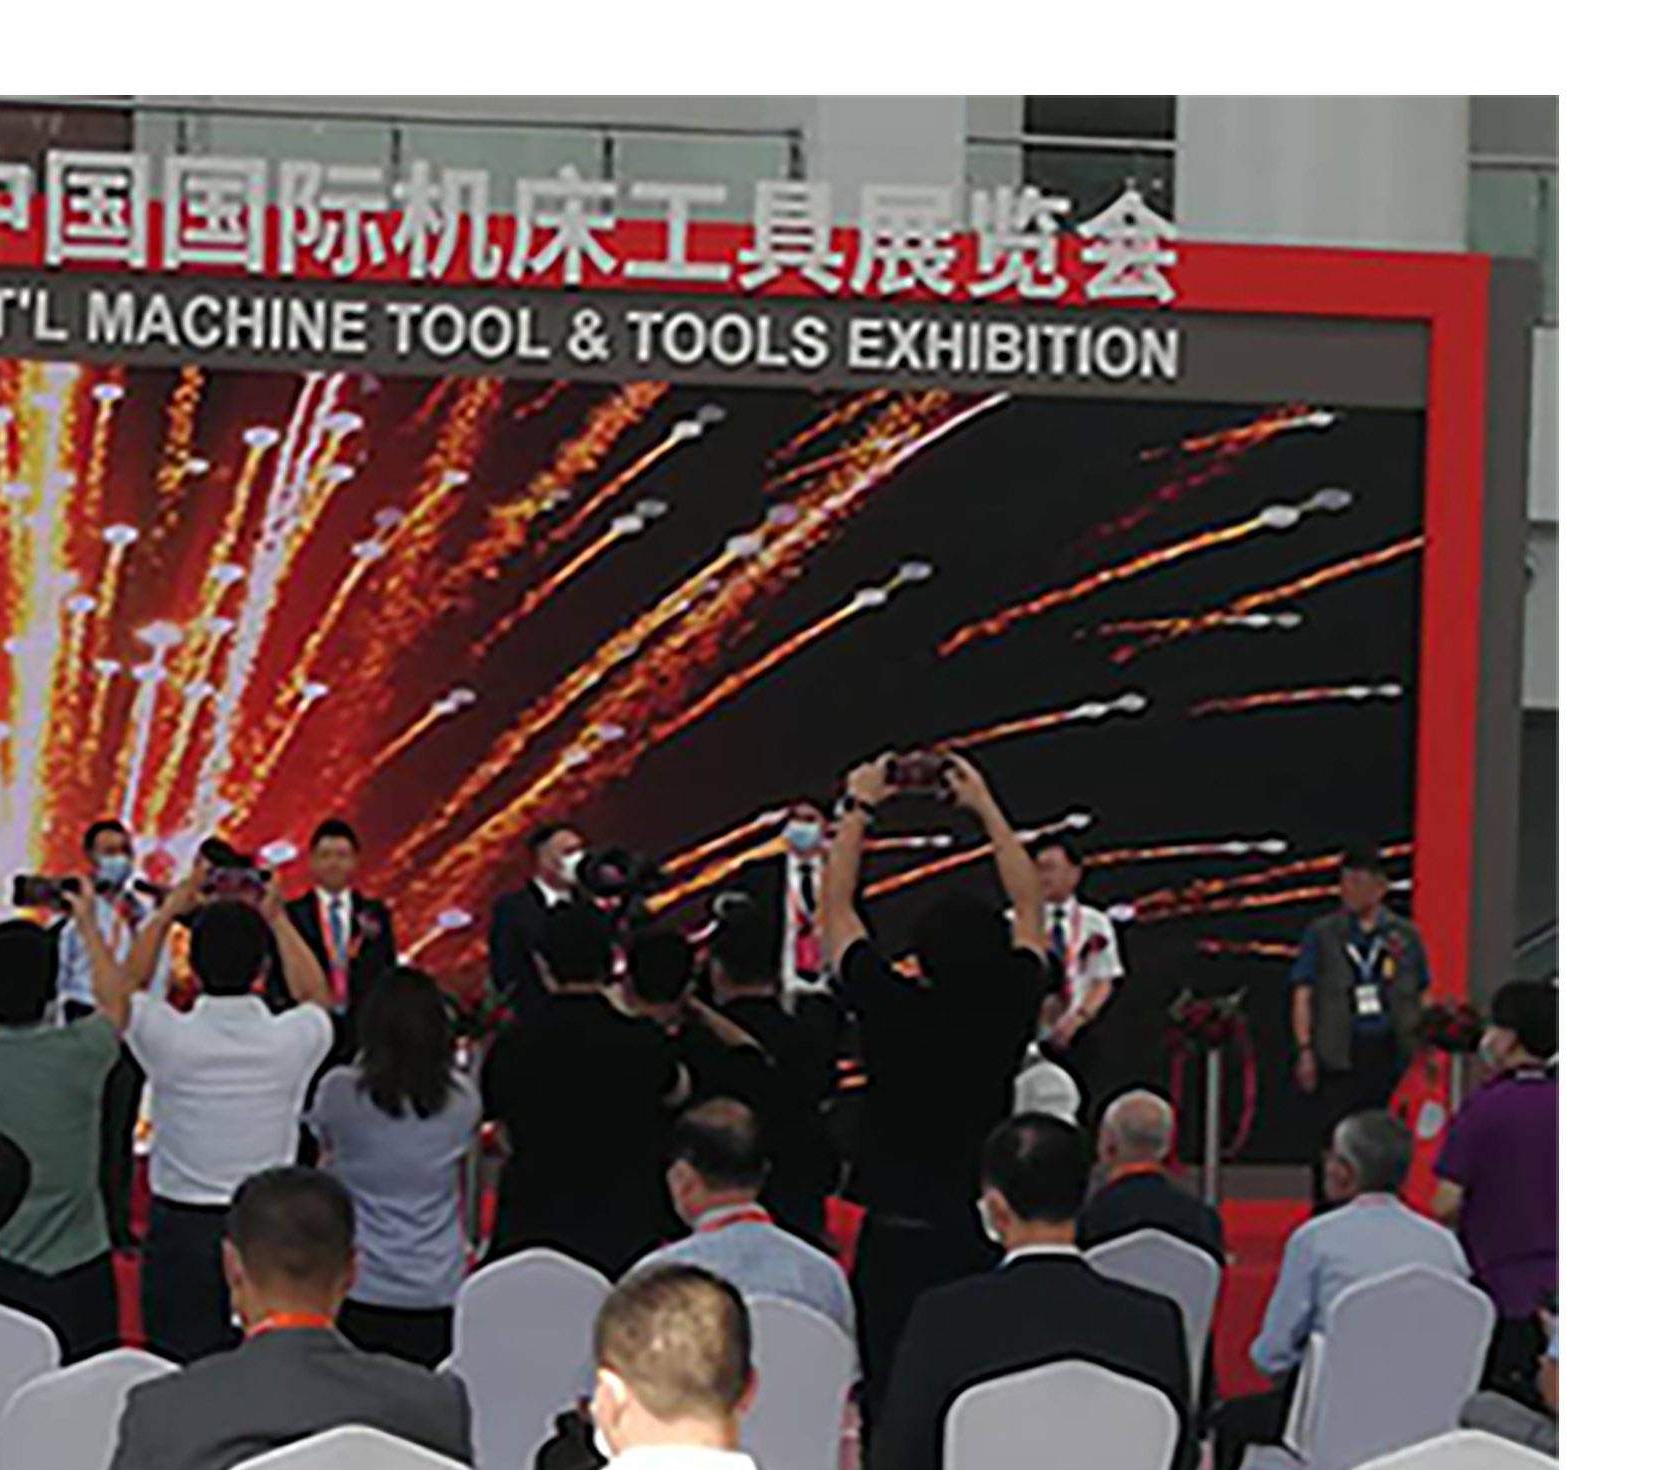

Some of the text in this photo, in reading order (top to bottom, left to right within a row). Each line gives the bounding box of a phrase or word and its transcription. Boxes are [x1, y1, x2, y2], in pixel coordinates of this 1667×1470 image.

[87, 290, 367, 355] MACHINE
[386, 302, 550, 359] TOOL
[568, 308, 609, 363] &
[628, 309, 828, 370] TOOLS
[848, 318, 1180, 381] EXHIBITION
